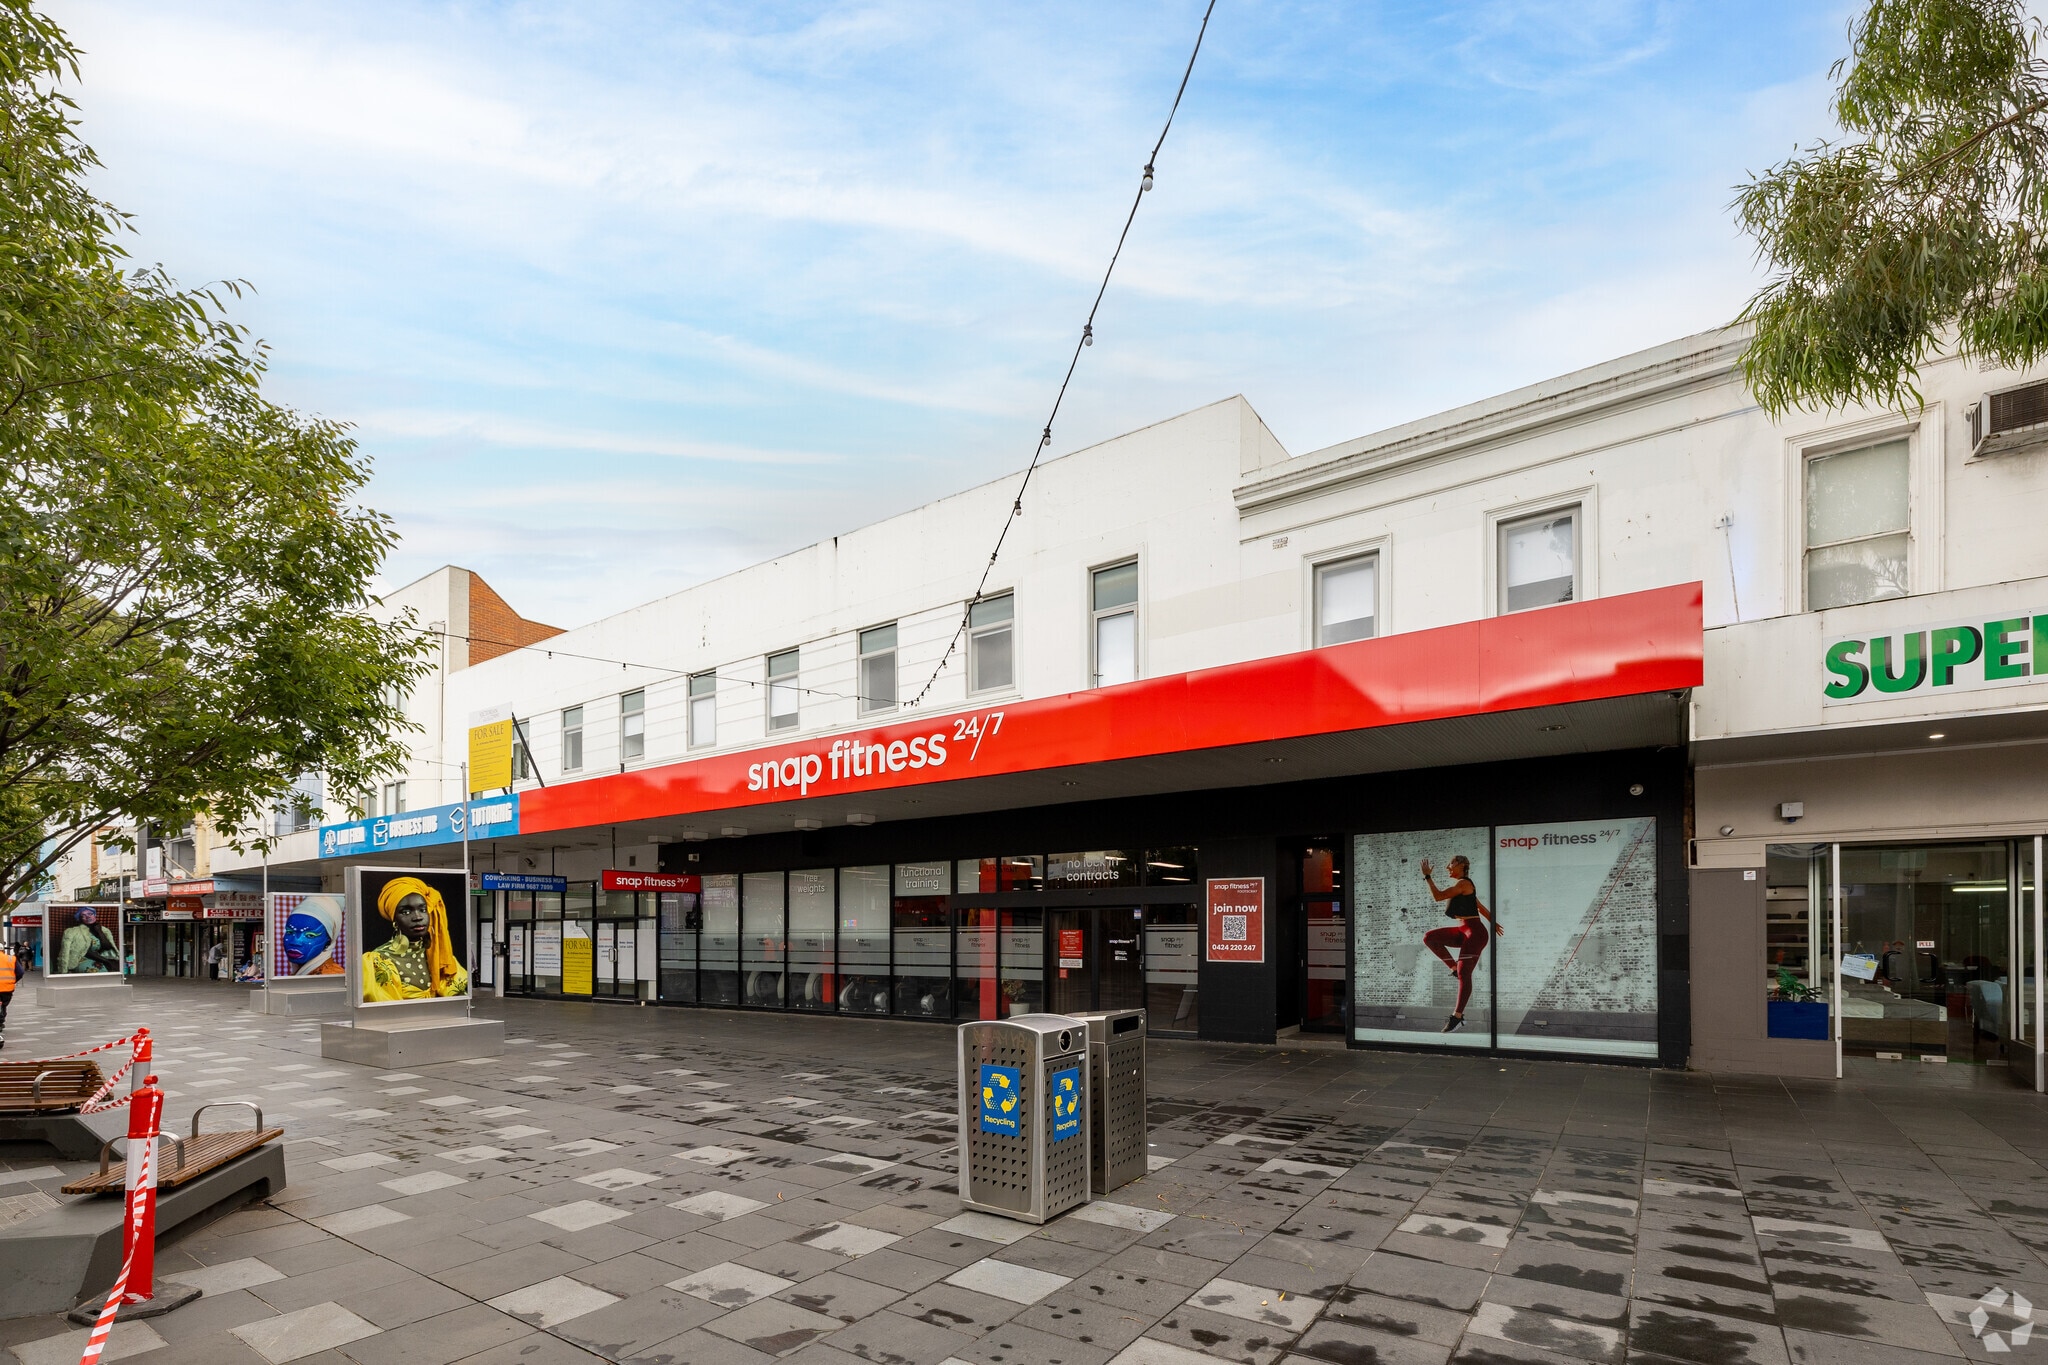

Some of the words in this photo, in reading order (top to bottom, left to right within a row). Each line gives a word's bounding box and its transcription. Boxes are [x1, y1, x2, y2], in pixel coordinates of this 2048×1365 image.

[474, 728, 488, 741] FOR
[489, 723, 505, 738] SALE
[747, 751, 823, 796] snap
[828, 733, 947, 780] fitness
[952, 712, 1005, 761] 24/7
[1500, 836, 1539, 850] snap
[1541, 833, 1597, 846] fitness
[1600, 829, 1621, 843] 24/7
[1067, 860, 1081, 868] no
[900, 866, 944, 877] functional
[1066, 869, 1120, 881] contracts
[525, 876, 552, 884] BUSINESS
[616, 876, 643, 888] snap
[643, 876, 677, 888] fitness
[676, 877, 690, 888] 24/7
[804, 873, 819, 882] free
[797, 884, 826, 895] weights
[905, 879, 939, 890] training
[1214, 883, 1230, 891] snap
[1229, 882, 1250, 890] fitness
[1213, 903, 1233, 916] join
[1234, 905, 1258, 913] now
[565, 940, 578, 950] FOR
[1211, 943, 1229, 951] 0424
[984, 1114, 1016, 1128] Recycling
[1056, 1119, 1078, 1132] Recycling
